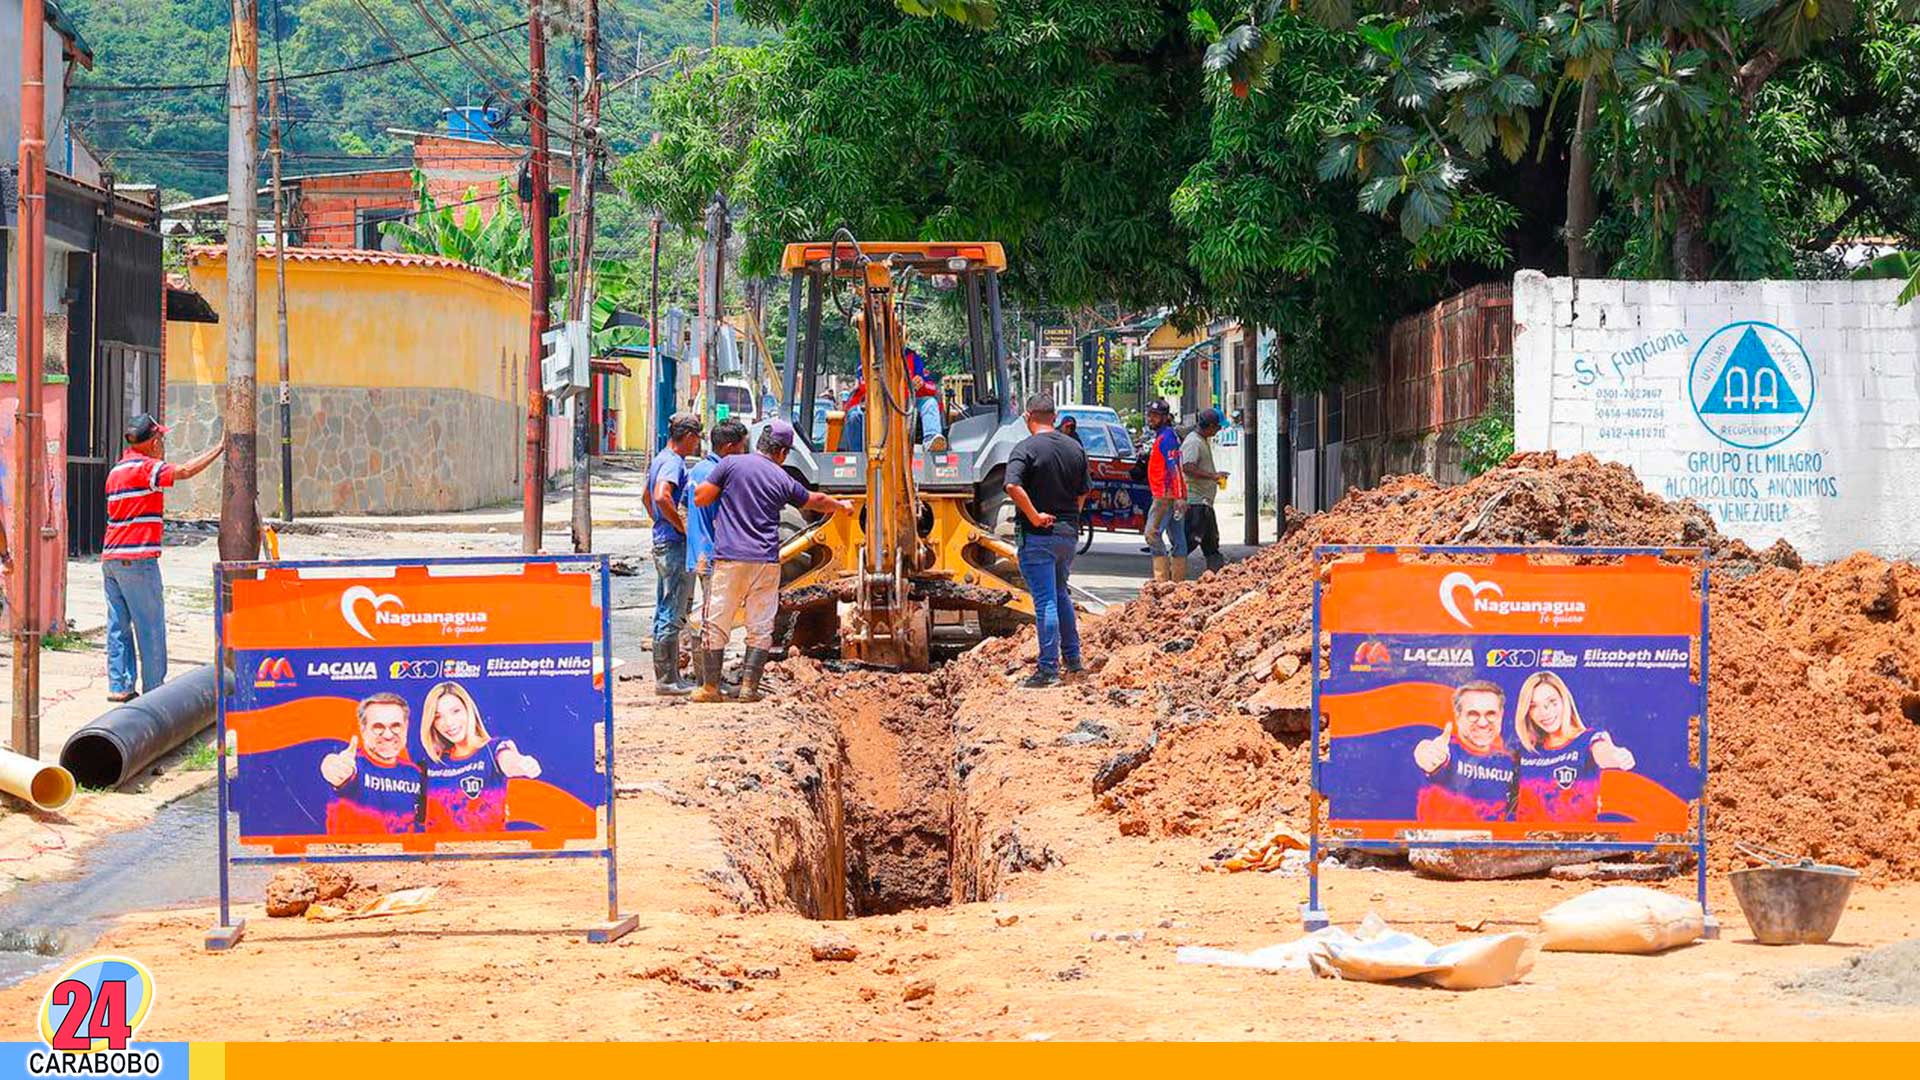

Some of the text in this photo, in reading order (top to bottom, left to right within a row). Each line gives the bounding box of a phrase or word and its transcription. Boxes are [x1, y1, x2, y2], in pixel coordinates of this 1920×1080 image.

[1096, 336, 1106, 407] PANADER
[1723, 365, 1779, 410] AA
[1747, 453, 1761, 473] EL
[1718, 502, 1791, 523] VENEZUELA
[1474, 599, 1586, 615] Naguanagua
[375, 611, 488, 626] Naguanagua
[1403, 648, 1474, 662] LACAVA
[1584, 649, 1689, 661] Elizabeth Niño
[307, 661, 377, 676] LACAVA
[487, 657, 591, 670] Elizabeth Niño
[1558, 769, 1573, 783] 10
[465, 781, 480, 794] 10
